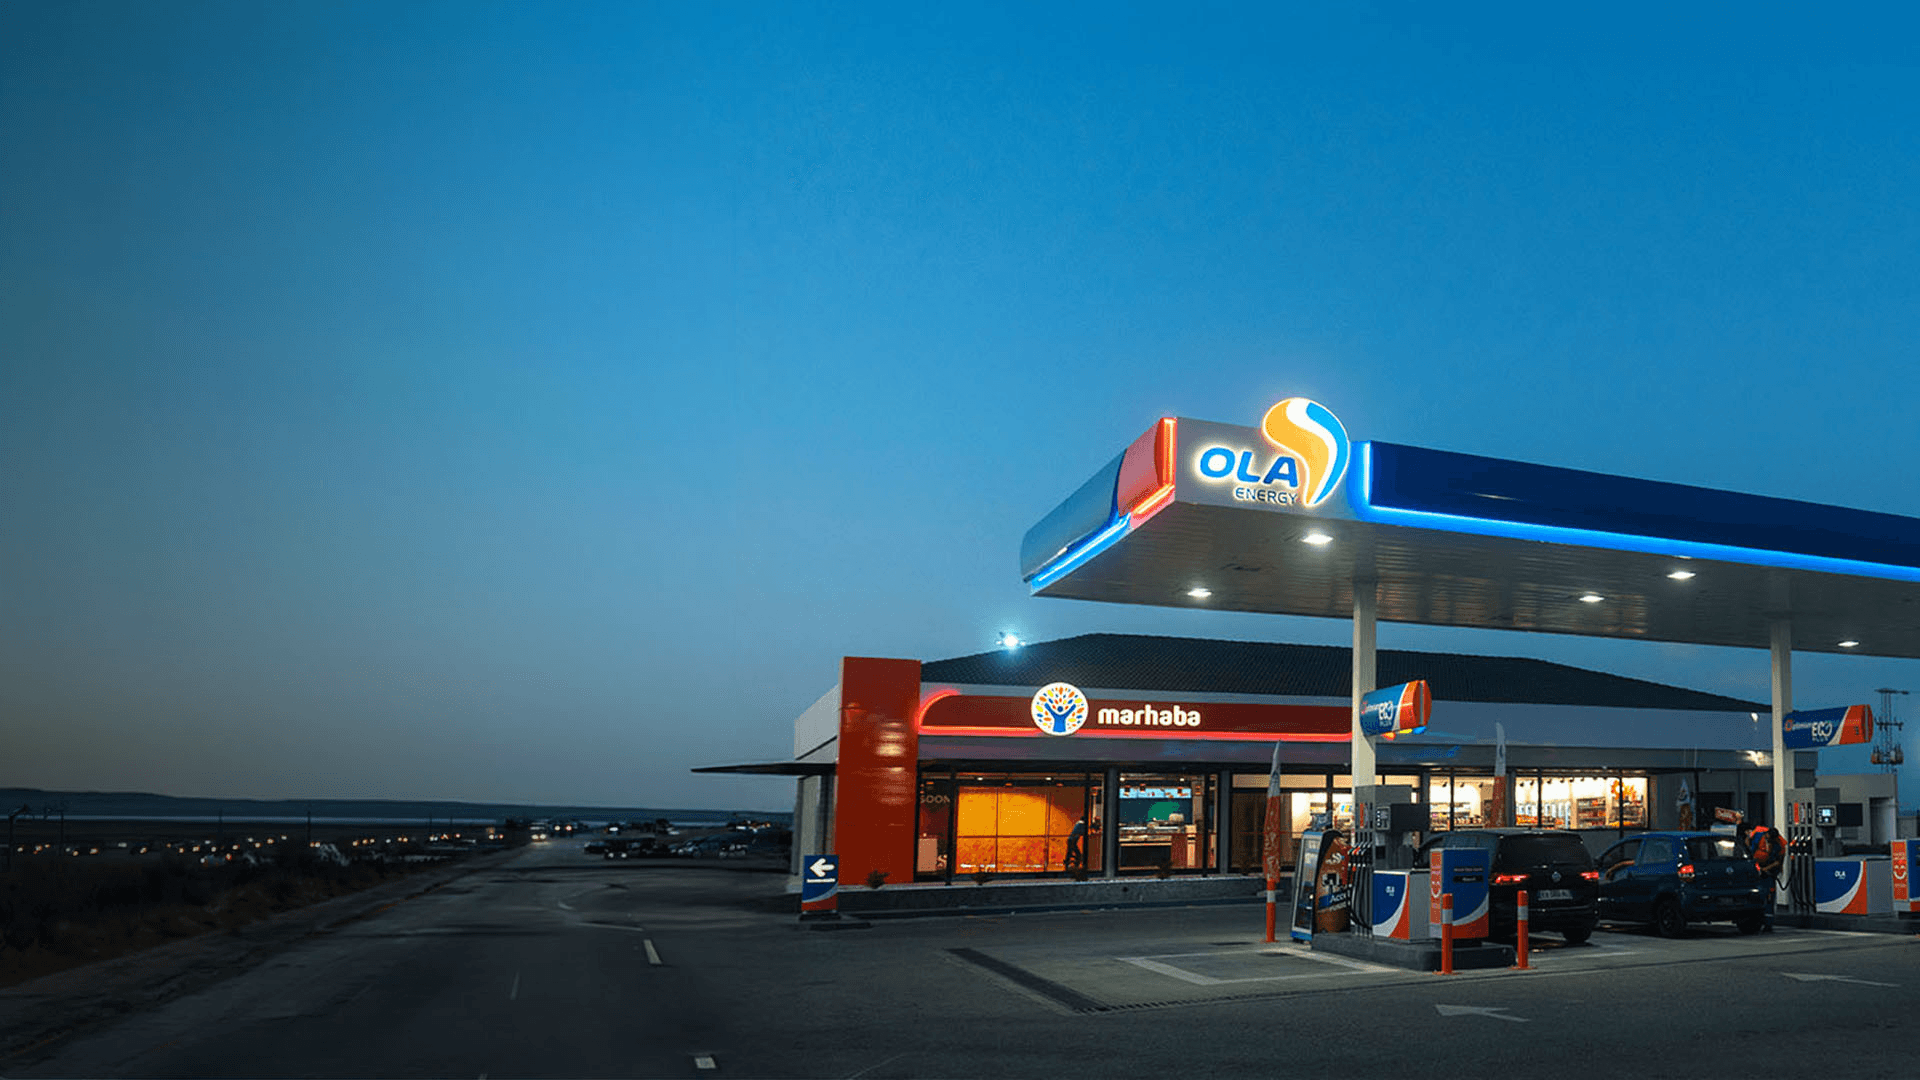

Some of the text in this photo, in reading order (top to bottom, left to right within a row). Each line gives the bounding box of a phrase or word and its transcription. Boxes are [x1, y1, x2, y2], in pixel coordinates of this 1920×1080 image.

[1199, 447, 1299, 488] OLA
[1235, 487, 1298, 505] ENERGY
[1097, 703, 1201, 728] marhaba
[1811, 721, 1833, 737] ECO
